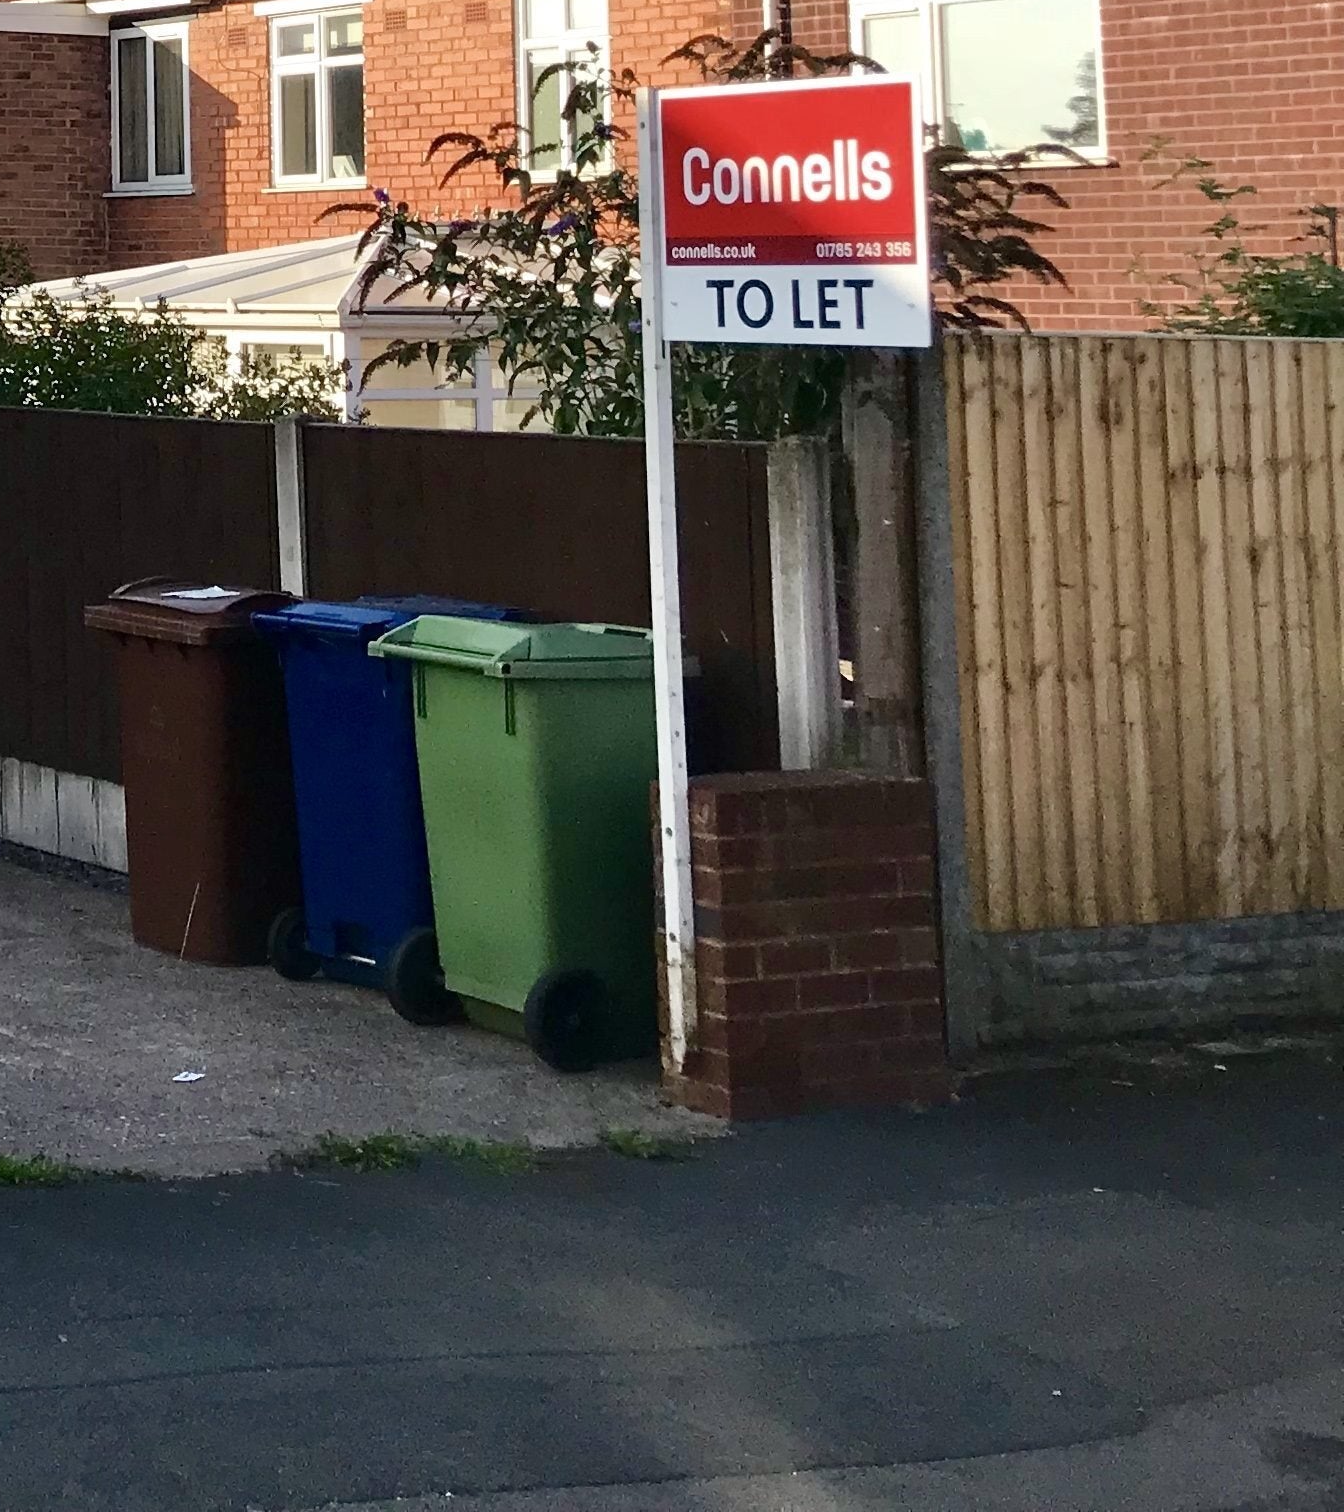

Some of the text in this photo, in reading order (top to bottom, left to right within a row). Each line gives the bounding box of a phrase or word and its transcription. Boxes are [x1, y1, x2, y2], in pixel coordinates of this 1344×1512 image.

[682, 138, 893, 206] Connells
[671, 242, 757, 260] connells.co.uk
[815, 241, 913, 259] 01785 243 356
[705, 278, 875, 330] TO LET
